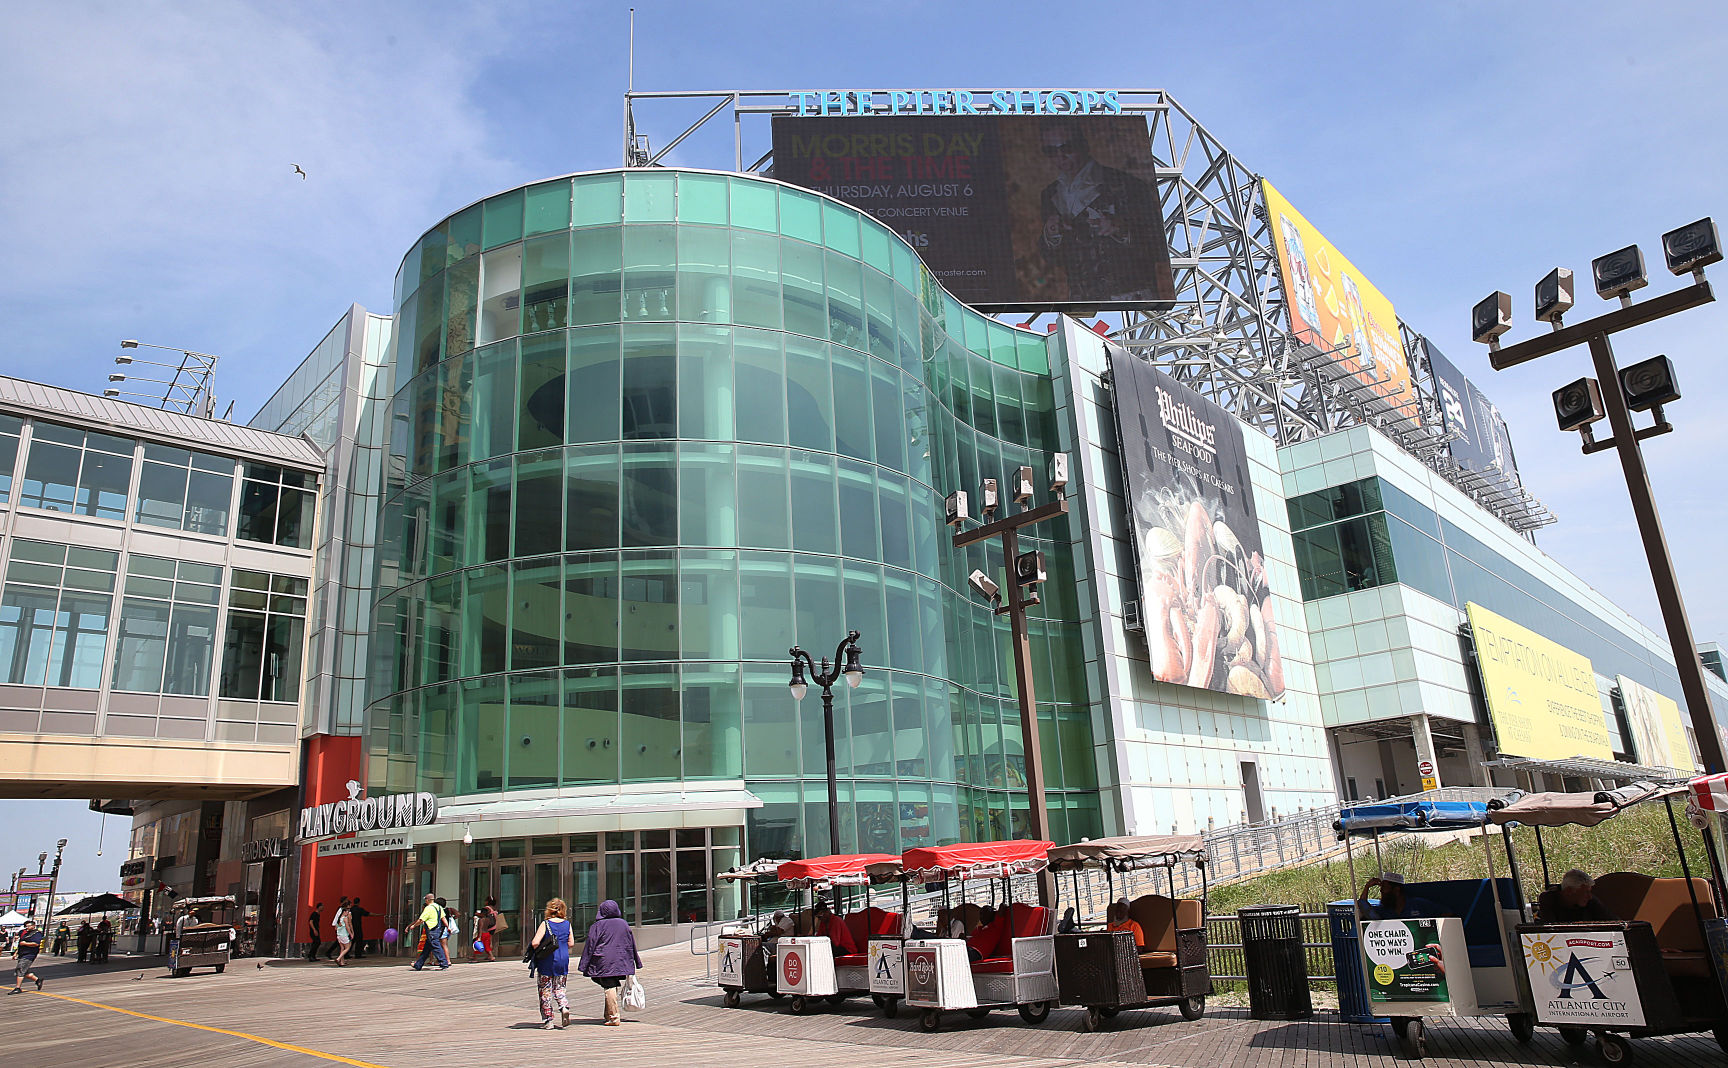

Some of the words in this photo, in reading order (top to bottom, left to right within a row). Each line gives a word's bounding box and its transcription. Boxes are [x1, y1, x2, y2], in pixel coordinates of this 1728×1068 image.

[789, 91, 873, 116] THE
[887, 91, 981, 116] PIER
[991, 90, 1122, 115] SHOPS
[792, 134, 913, 158] MORRIS
[922, 133, 985, 157] DAY
[809, 158, 832, 182] &
[840, 157, 894, 181] THE
[902, 155, 972, 180] TIME
[897, 184, 960, 198] AUGUST
[963, 184, 974, 197] 6
[877, 208, 934, 218] CONCERT
[935, 207, 969, 217] VENUE
[1155, 386, 1217, 451] Phillips
[1172, 434, 1213, 464] SEAFOOD
[1152, 446, 1167, 463] THE
[1167, 455, 1181, 470] PIER
[1182, 461, 1203, 480] SHOPS
[1211, 475, 1235, 495] CAESARS
[299, 791, 438, 839] PLAYGROUND
[319, 845, 330, 853] ONE
[333, 840, 369, 851] ATLANTIC
[373, 838, 404, 847] OCEAN
[1368, 931, 1383, 939] ONE
[1384, 930, 1409, 938] CHAIR.
[1370, 940, 1386, 948] TWO
[1387, 939, 1408, 947] WAYS
[1568, 940, 1612, 948] ACAIRPORT.COM
[1387, 948, 1405, 956] WIN.
[788, 959, 798, 967] DO
[909, 961, 922, 972] Hard
[922, 961, 935, 974] Rock
[788, 971, 798, 979] AC
[1548, 1000, 1600, 1010] ATLANTIC
[1602, 1001, 1627, 1011] CITY
[1549, 1010, 1599, 1018] INTERNATIONAL
